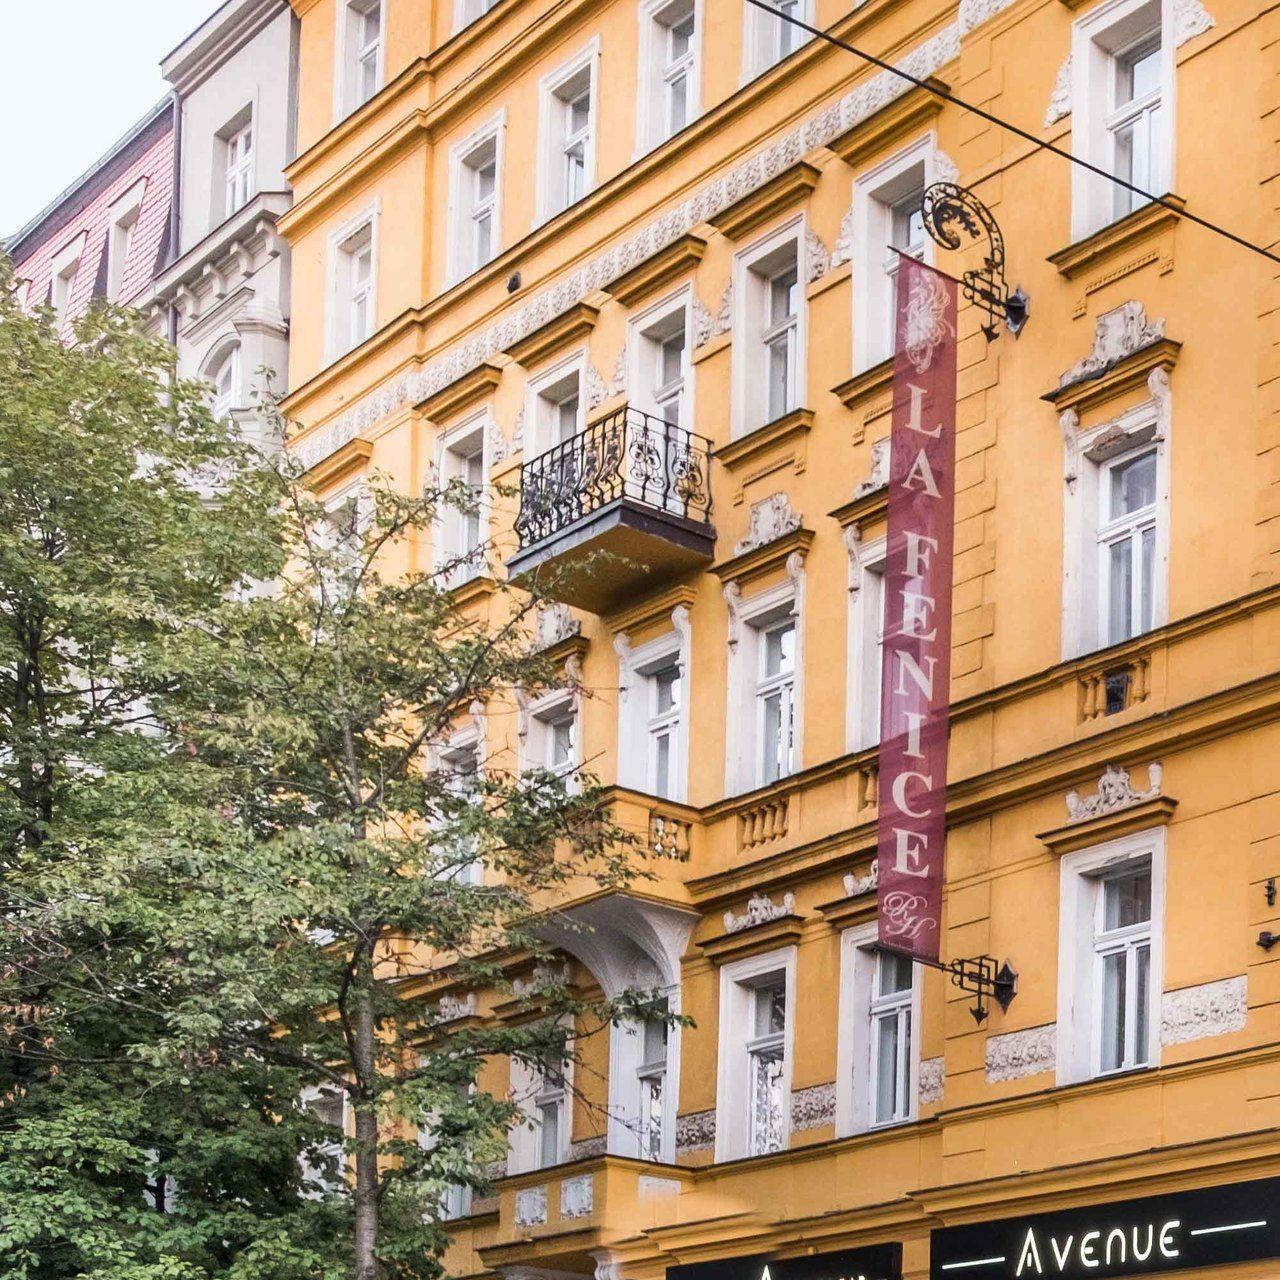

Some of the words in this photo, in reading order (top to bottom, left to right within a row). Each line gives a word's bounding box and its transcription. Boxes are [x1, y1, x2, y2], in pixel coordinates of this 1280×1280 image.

[901, 383, 942, 499] LA
[891, 530, 938, 878] FENICE
[1014, 1219, 1181, 1277] AVENUE
